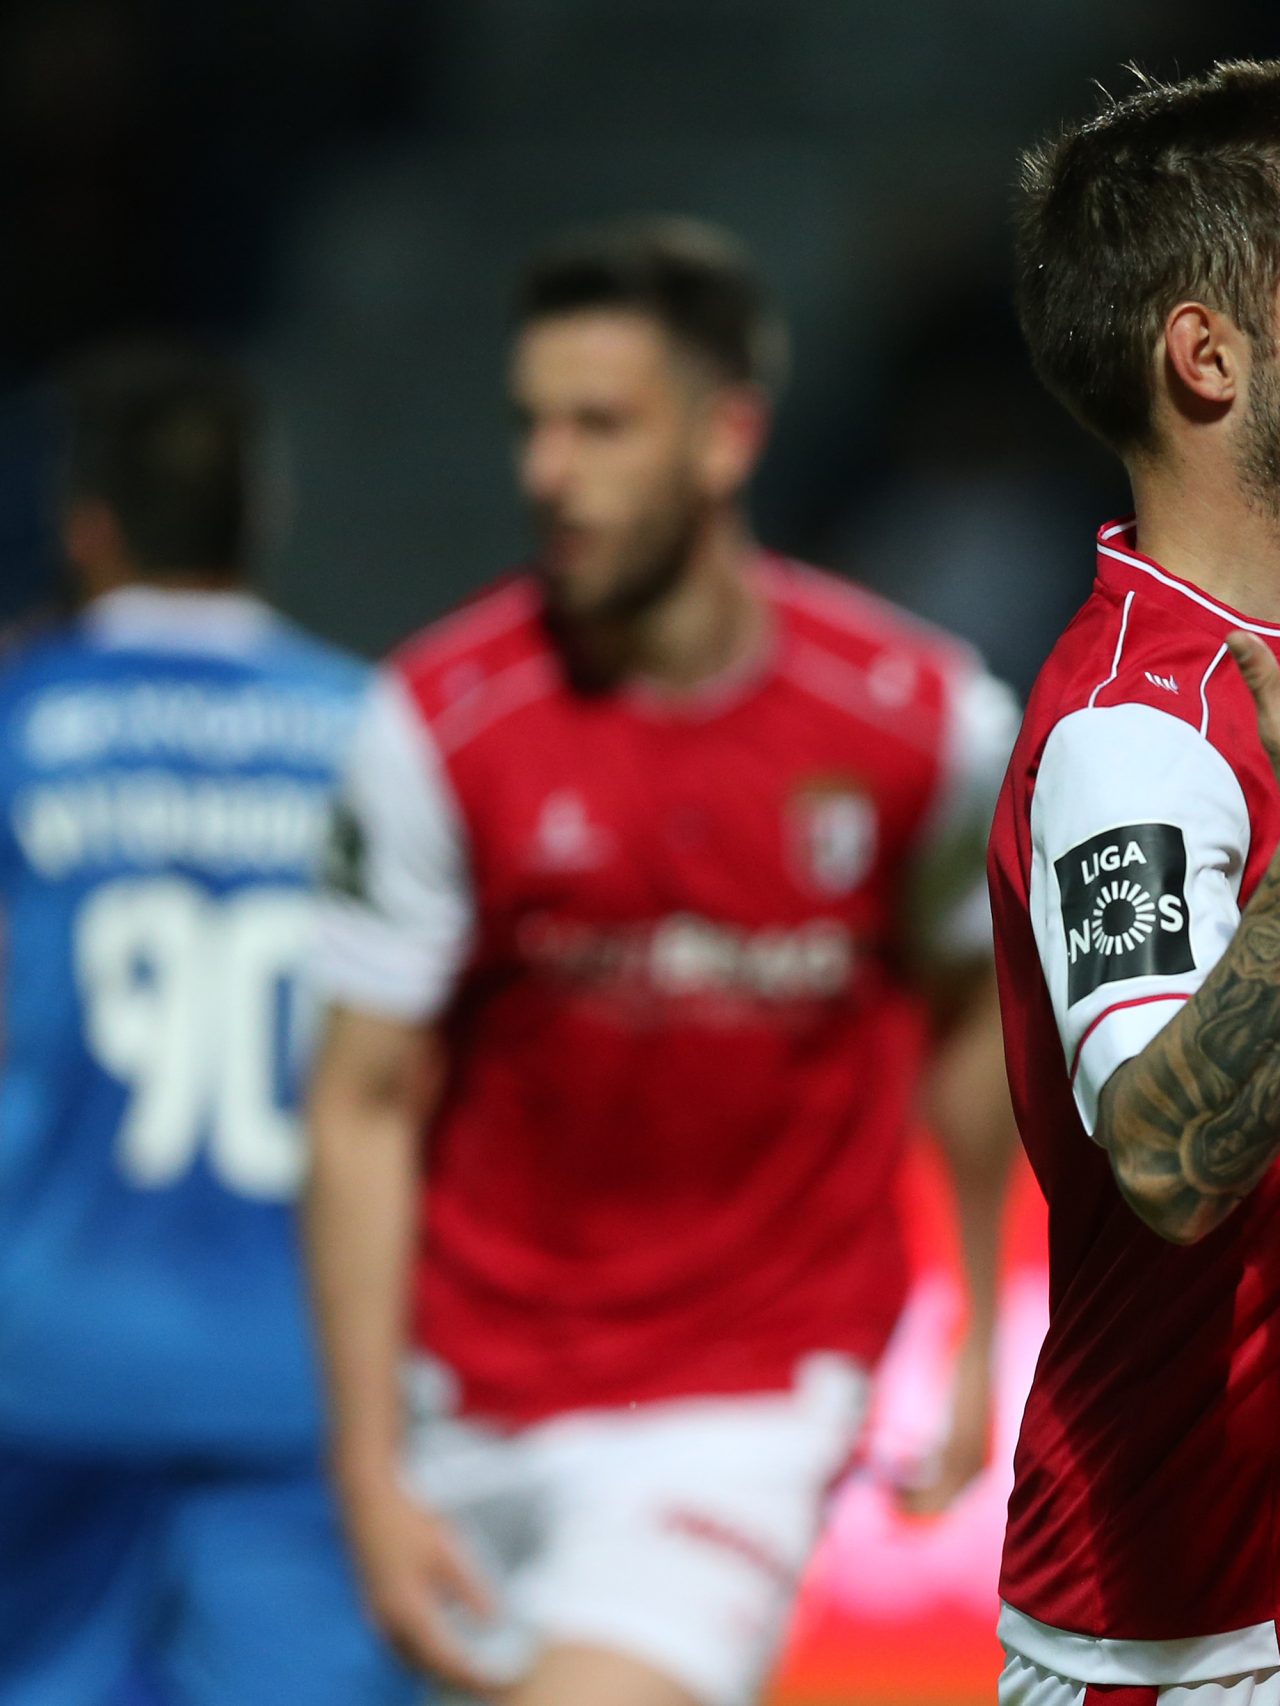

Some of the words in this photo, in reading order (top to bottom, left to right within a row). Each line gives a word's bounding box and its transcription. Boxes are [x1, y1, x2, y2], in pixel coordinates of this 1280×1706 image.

[1081, 841, 1147, 885] LIGA
[1069, 894, 1184, 964] NOS
[72, 878, 318, 1197] 90
